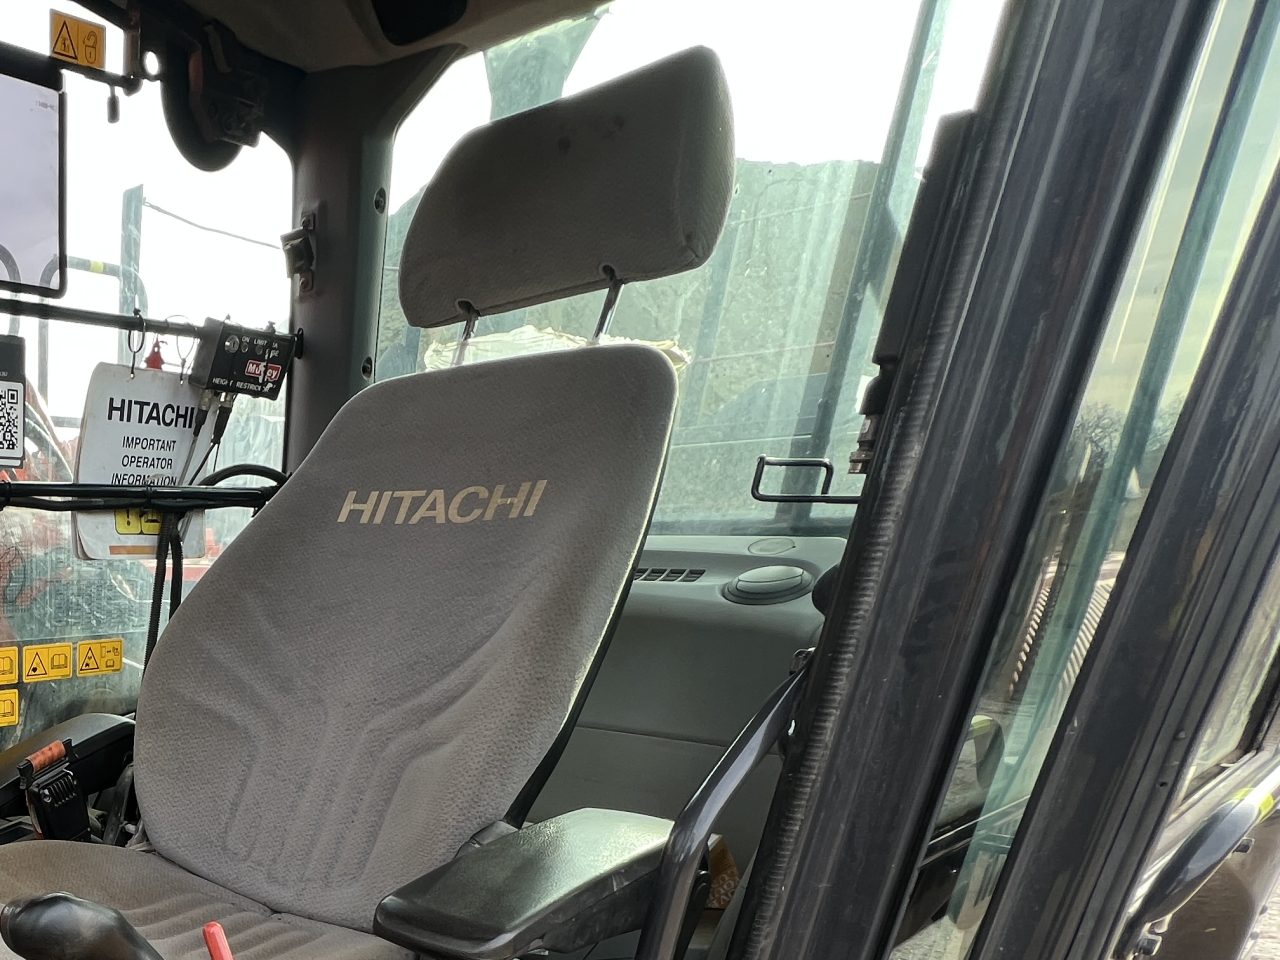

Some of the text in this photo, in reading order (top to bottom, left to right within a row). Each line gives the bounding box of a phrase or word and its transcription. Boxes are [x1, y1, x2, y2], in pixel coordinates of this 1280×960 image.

[247, 363, 278, 379] Muey
[107, 397, 195, 429] HITACHI
[122, 435, 177, 452] IMPORTANT
[121, 454, 173, 470] OPERATOR
[336, 479, 548, 525] HITACHI
